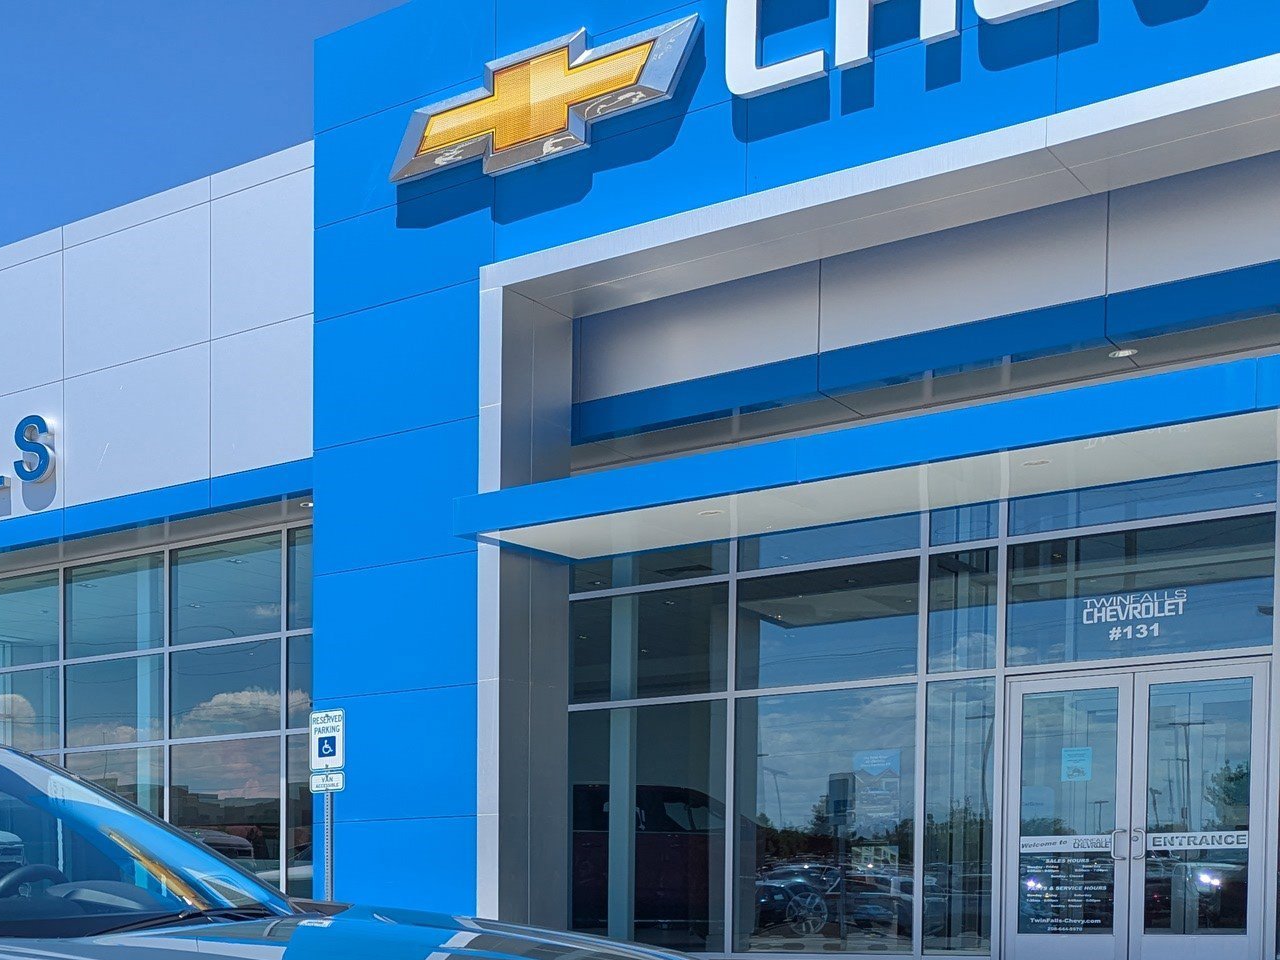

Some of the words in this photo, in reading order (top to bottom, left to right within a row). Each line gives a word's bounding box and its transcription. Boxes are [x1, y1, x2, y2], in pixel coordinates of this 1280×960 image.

[1083, 589, 1187, 608] TWINFALLS
[1083, 599, 1187, 624] CHEVROLET
[1109, 622, 1159, 641] #131
[312, 714, 342, 725] RESERVED
[314, 725, 340, 735] PARKING
[1021, 841, 1057, 849] Welcome
[1152, 834, 1247, 847] ENTRANCE
[1029, 917, 1102, 925] TwinFalls-Chevy.com
